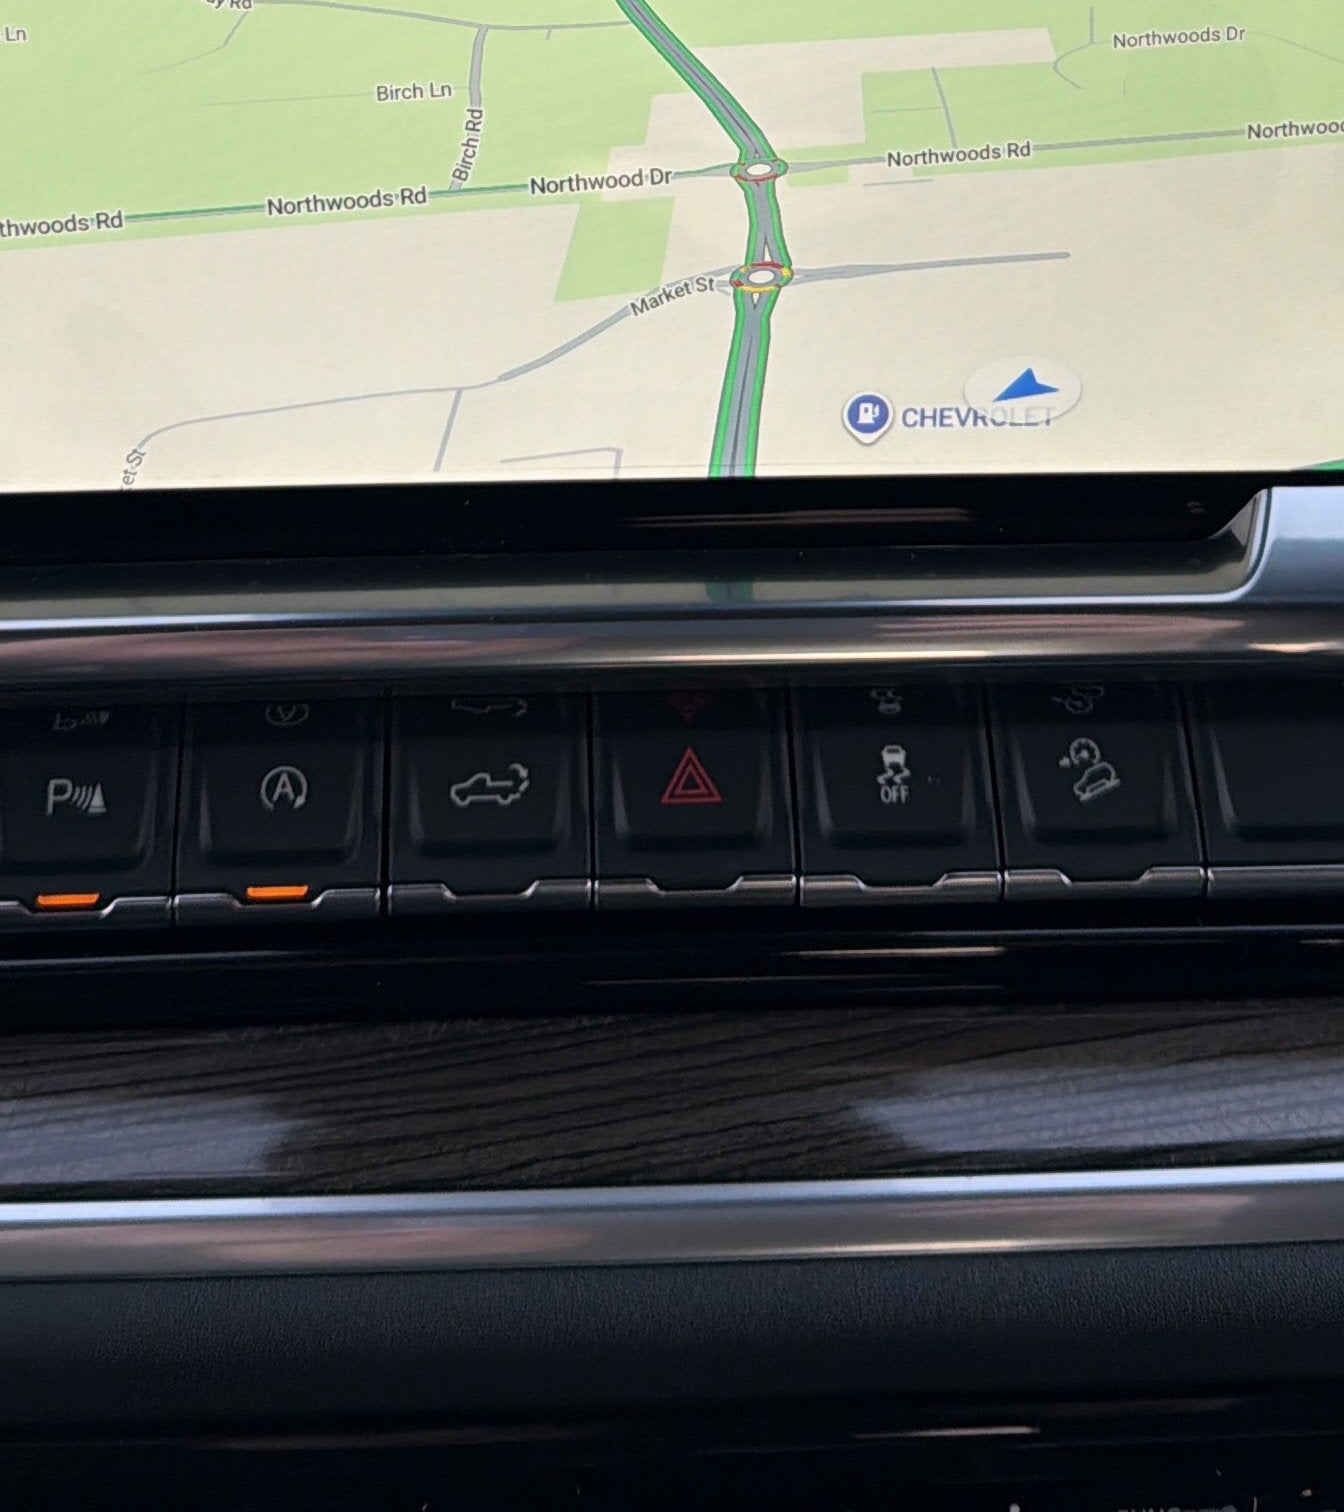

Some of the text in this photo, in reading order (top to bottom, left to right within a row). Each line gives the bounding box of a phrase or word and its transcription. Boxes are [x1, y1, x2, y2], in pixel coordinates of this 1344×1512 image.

[4, 25, 27, 42] Ln
[1112, 25, 1247, 50] Northwoods Dr
[375, 82, 453, 103] Birch Ln
[451, 108, 484, 182] Birch Rd
[886, 141, 1032, 168] Northwoods Rd
[529, 167, 673, 196] Northwood Dr
[266, 186, 428, 217] Northwoods Rd
[95, 210, 125, 230] Rd
[629, 276, 716, 318] Market St
[120, 448, 147, 490] et St
[879, 785, 910, 804] OFF
